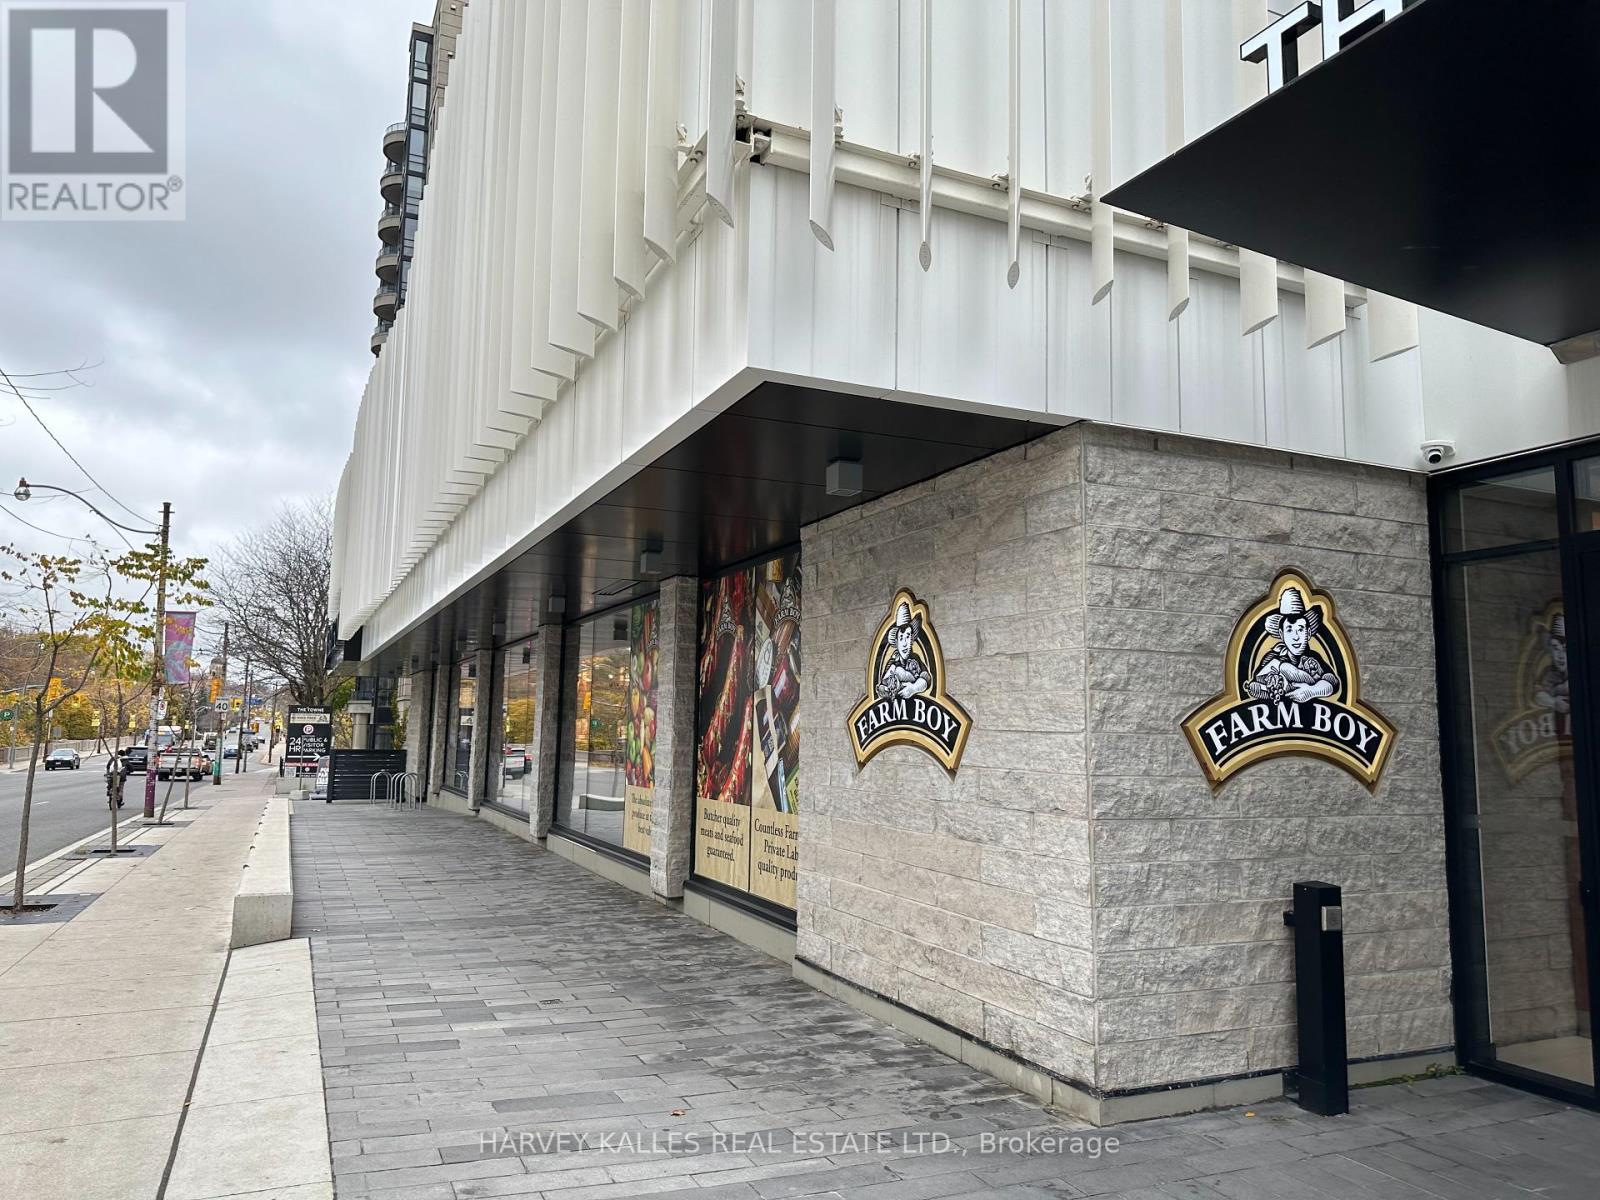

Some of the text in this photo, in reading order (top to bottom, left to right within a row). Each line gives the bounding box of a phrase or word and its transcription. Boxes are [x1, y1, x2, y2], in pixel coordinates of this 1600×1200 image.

[857, 699, 958, 743] FARM BOY
[1205, 701, 1378, 755] FARM BOY
[288, 745, 302, 753] HR
[289, 737, 302, 746] 24
[703, 808, 742, 832] Butcher quality
[754, 818, 784, 838] Countless
[700, 827, 744, 847] meats and seafood
[763, 839, 786, 858] Private
[757, 859, 779, 879] quality
